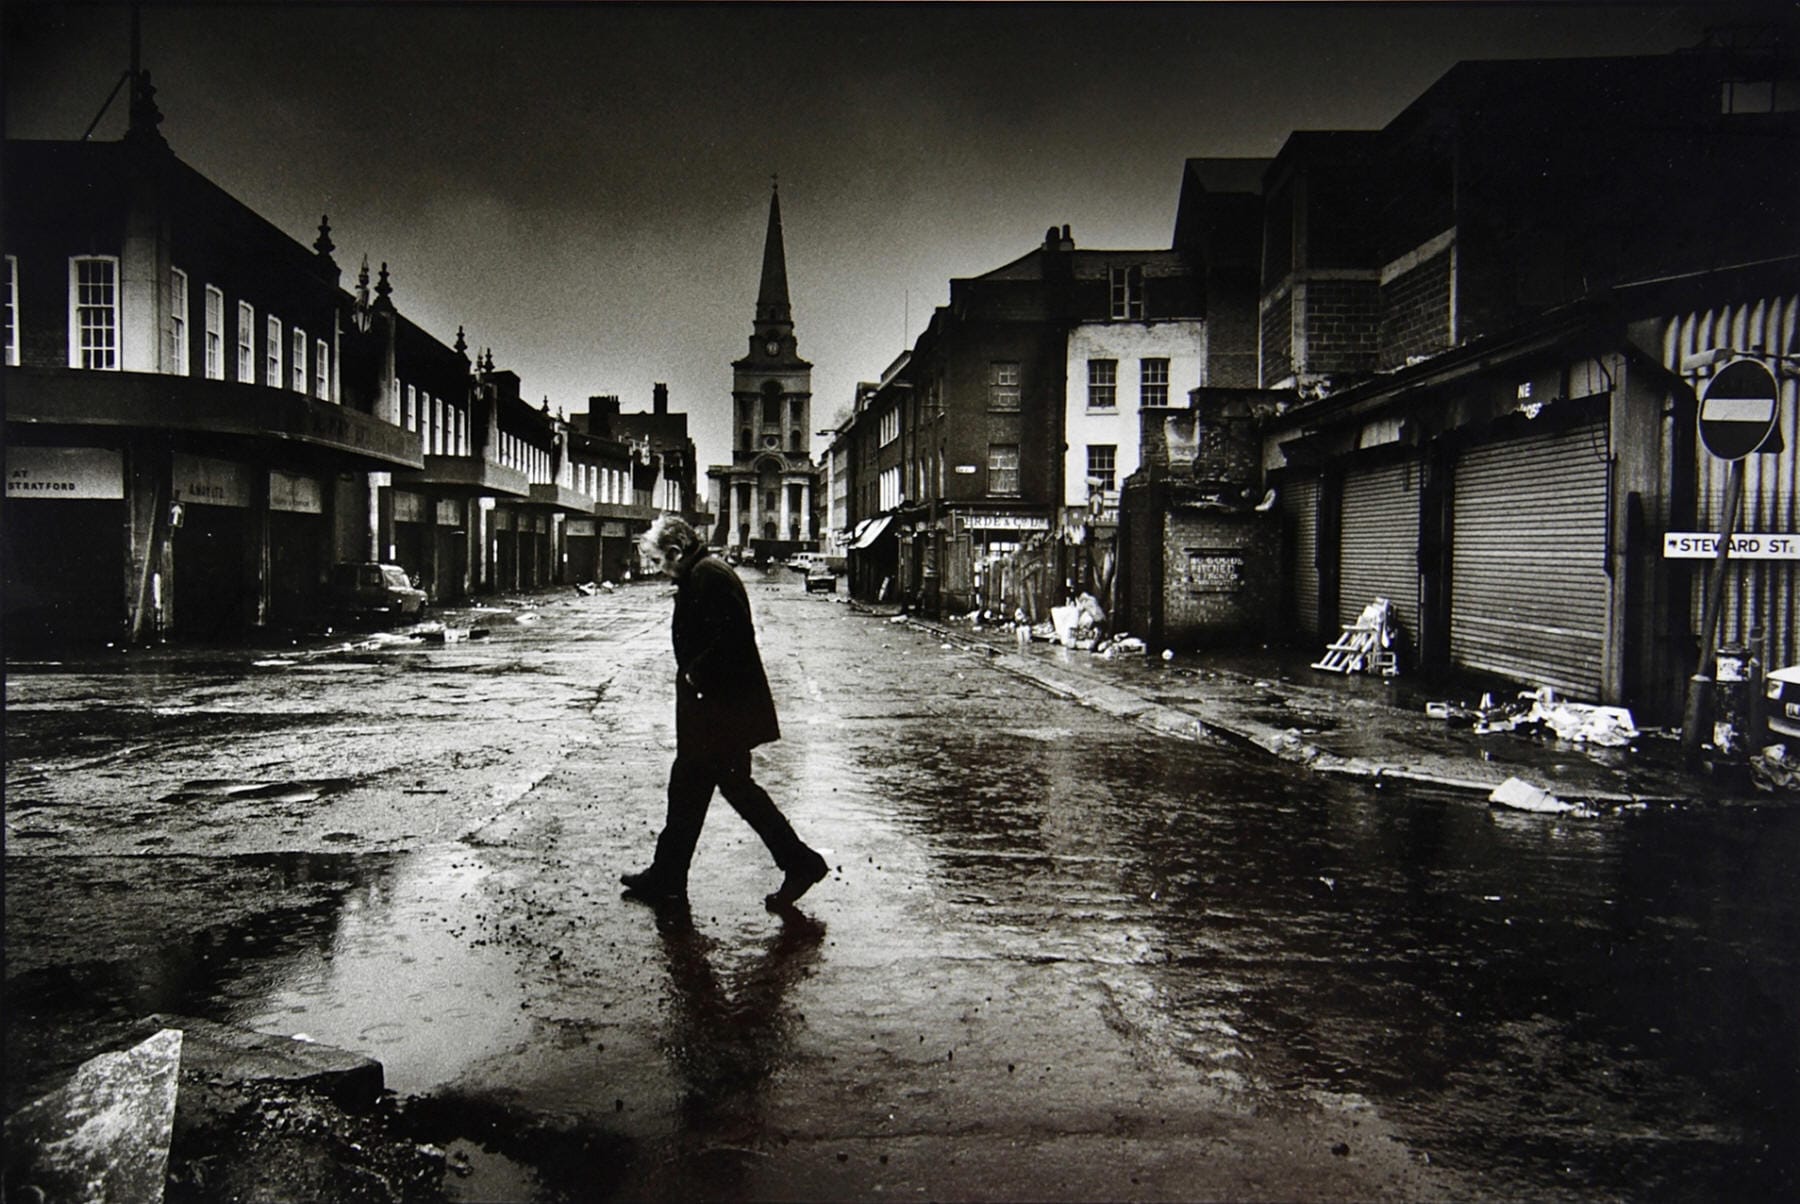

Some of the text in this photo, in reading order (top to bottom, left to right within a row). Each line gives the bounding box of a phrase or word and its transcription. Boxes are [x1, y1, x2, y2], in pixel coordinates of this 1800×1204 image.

[12, 469, 28, 478] AT
[7, 482, 75, 491] STRATFORD
[1769, 539, 1790, 553] ST
